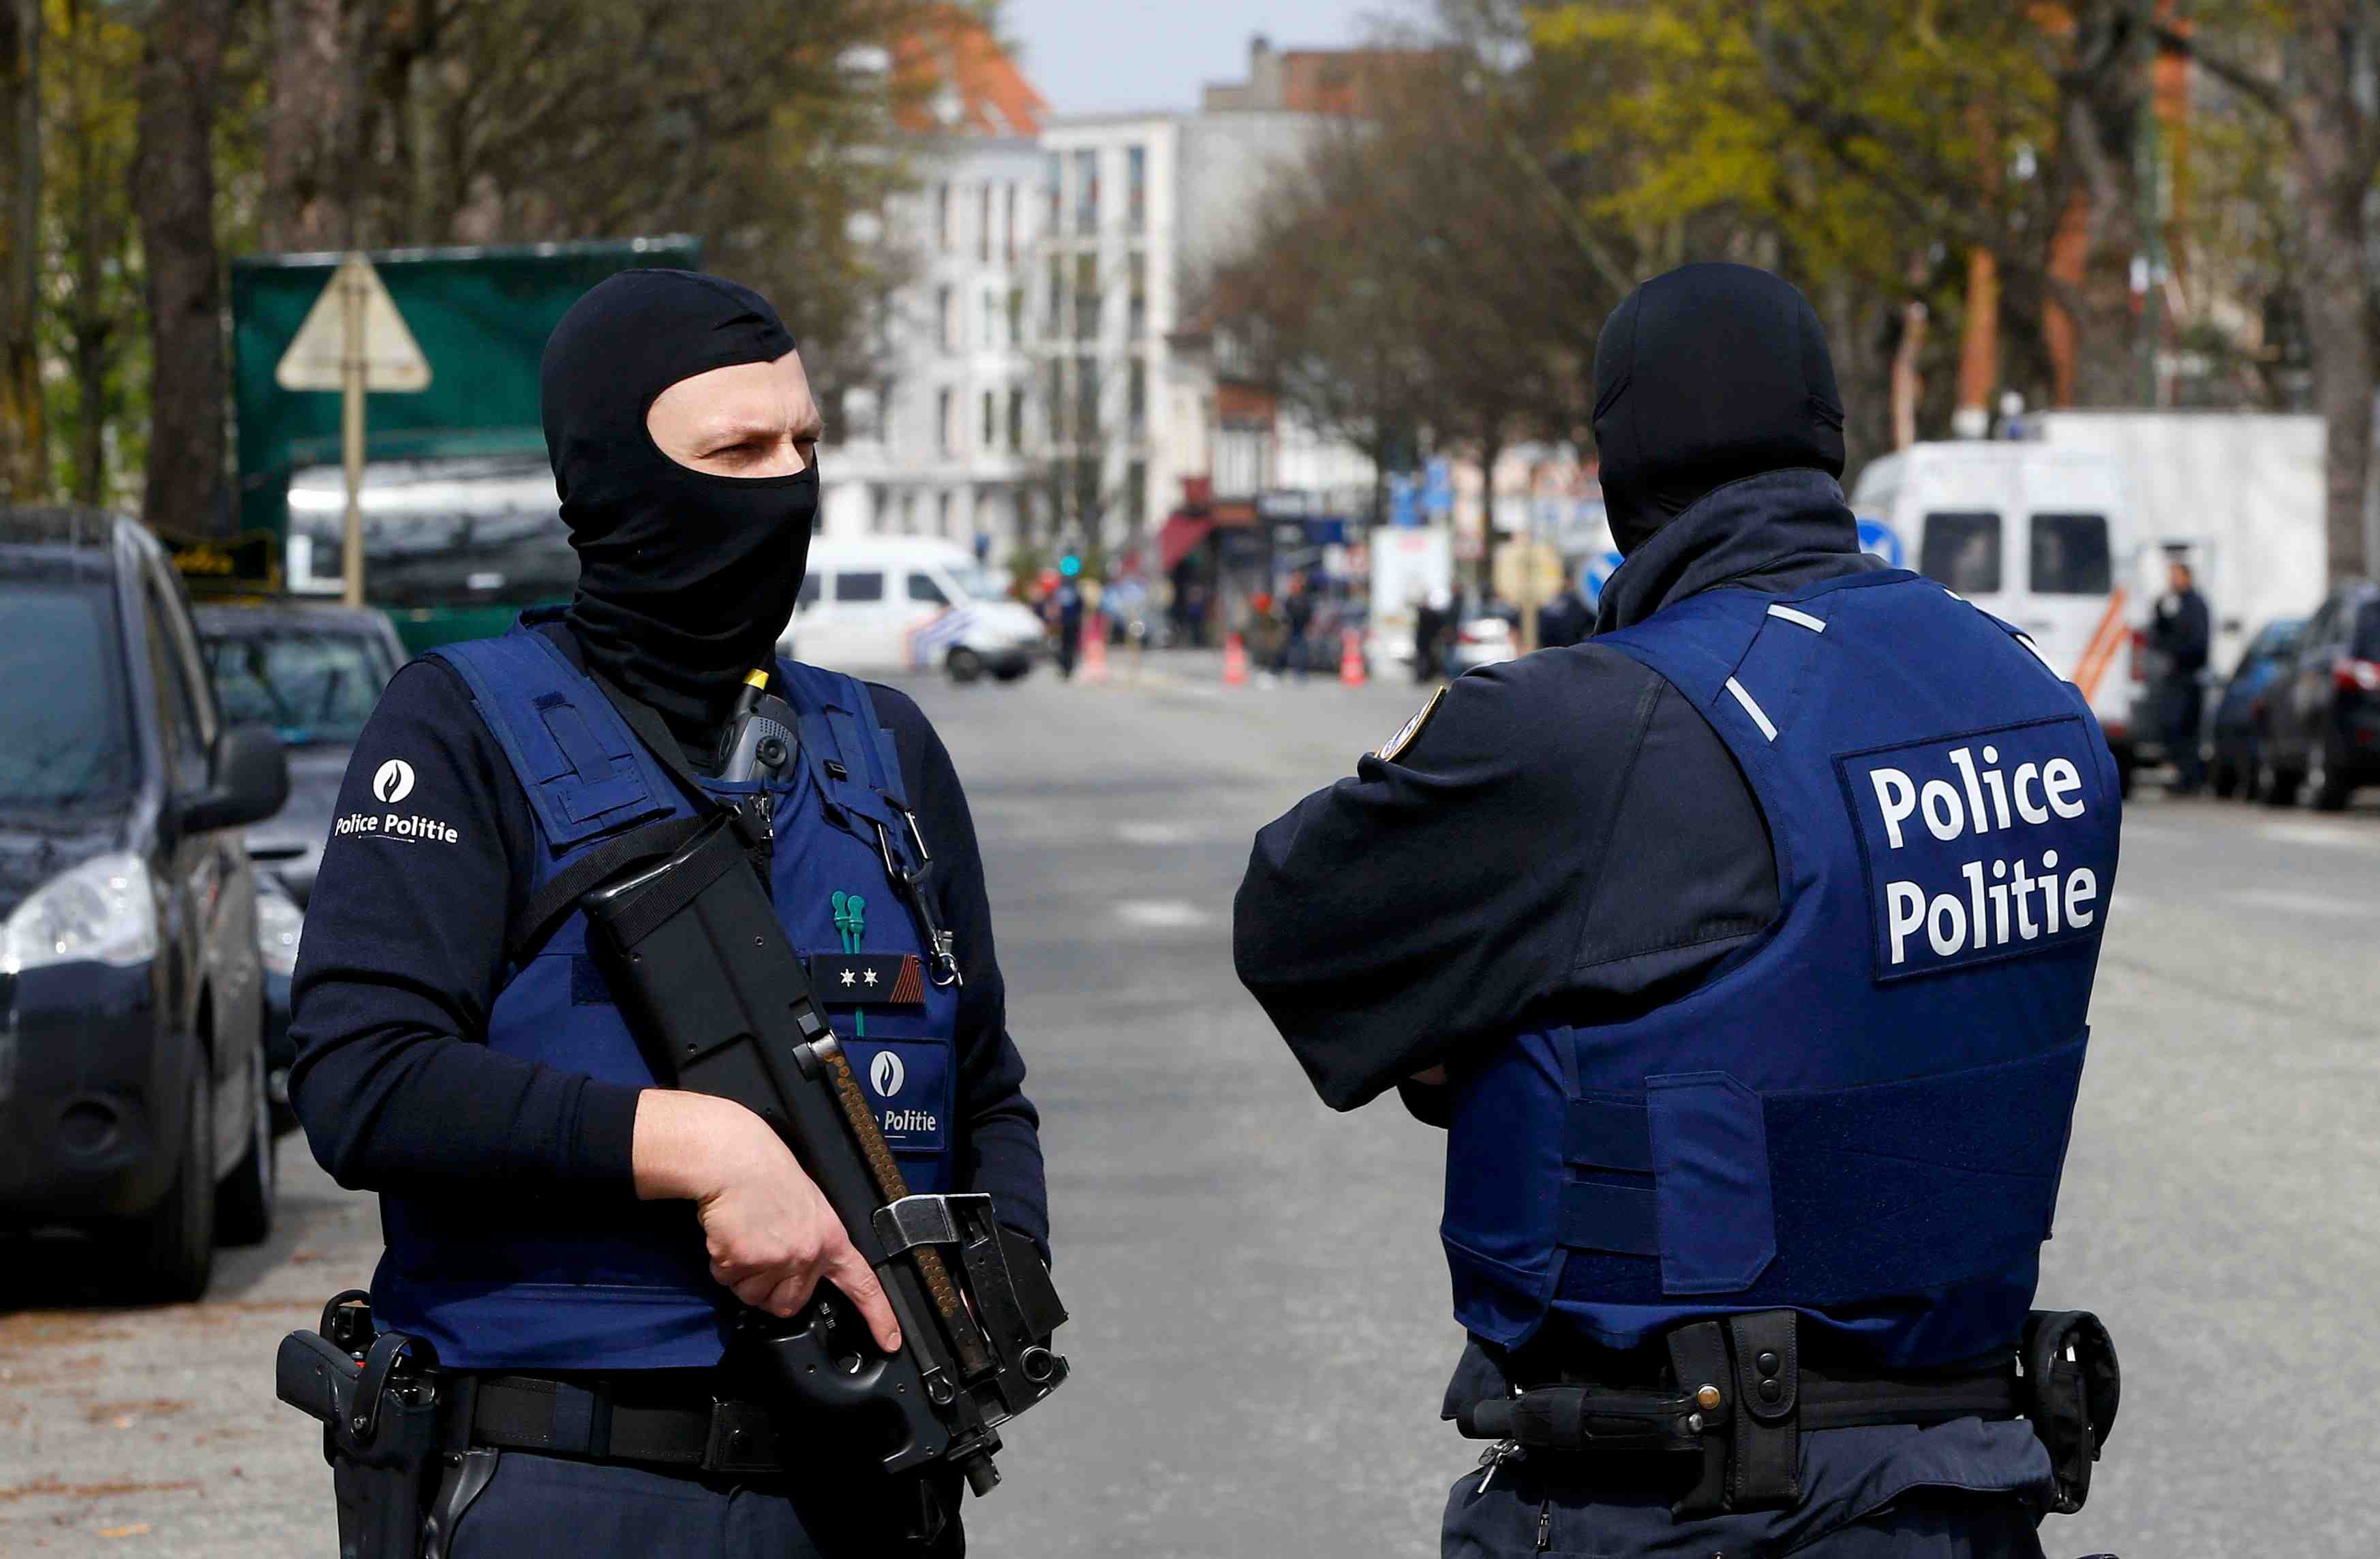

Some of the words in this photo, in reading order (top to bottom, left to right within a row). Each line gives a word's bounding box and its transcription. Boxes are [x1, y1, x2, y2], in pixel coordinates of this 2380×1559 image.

[334, 813, 378, 837] Police
[384, 814, 459, 844] Politie
[1869, 745, 2086, 850] Police
[1885, 849, 2098, 965] Politie
[884, 1109, 937, 1131] Politie
